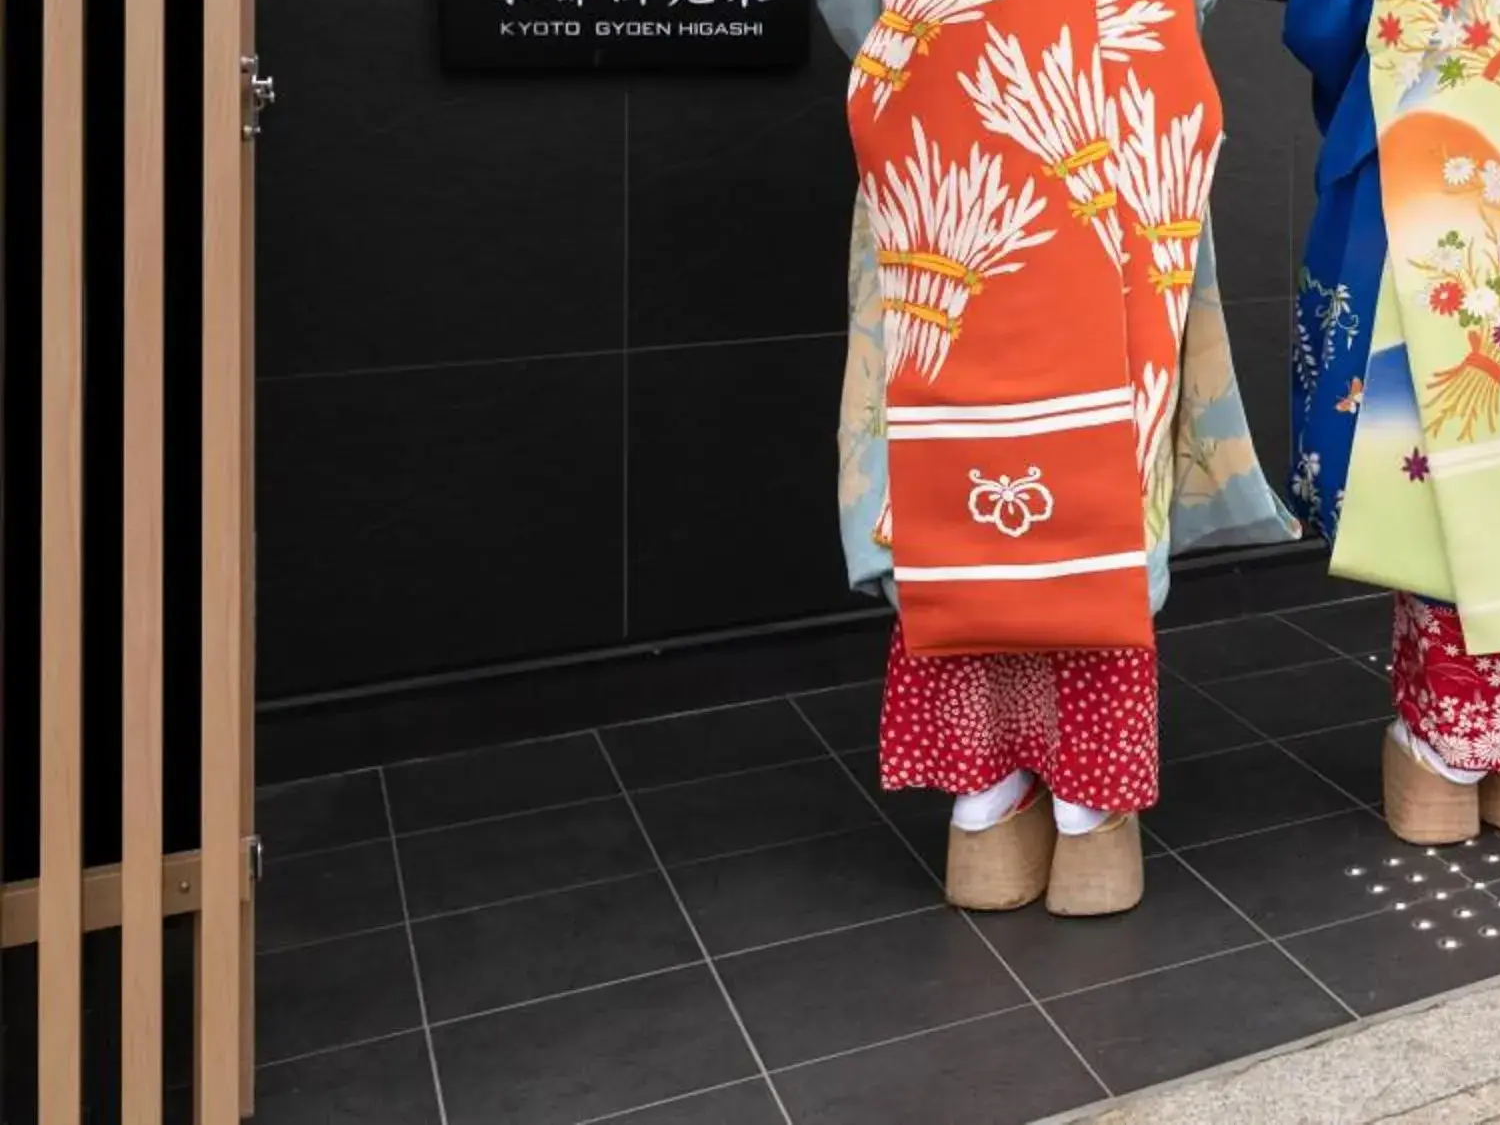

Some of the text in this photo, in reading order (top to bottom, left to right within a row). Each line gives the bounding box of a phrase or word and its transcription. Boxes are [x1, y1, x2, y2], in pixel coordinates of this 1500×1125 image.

[500, 21, 763, 36] KYOTO GYOEN HIGASHI
